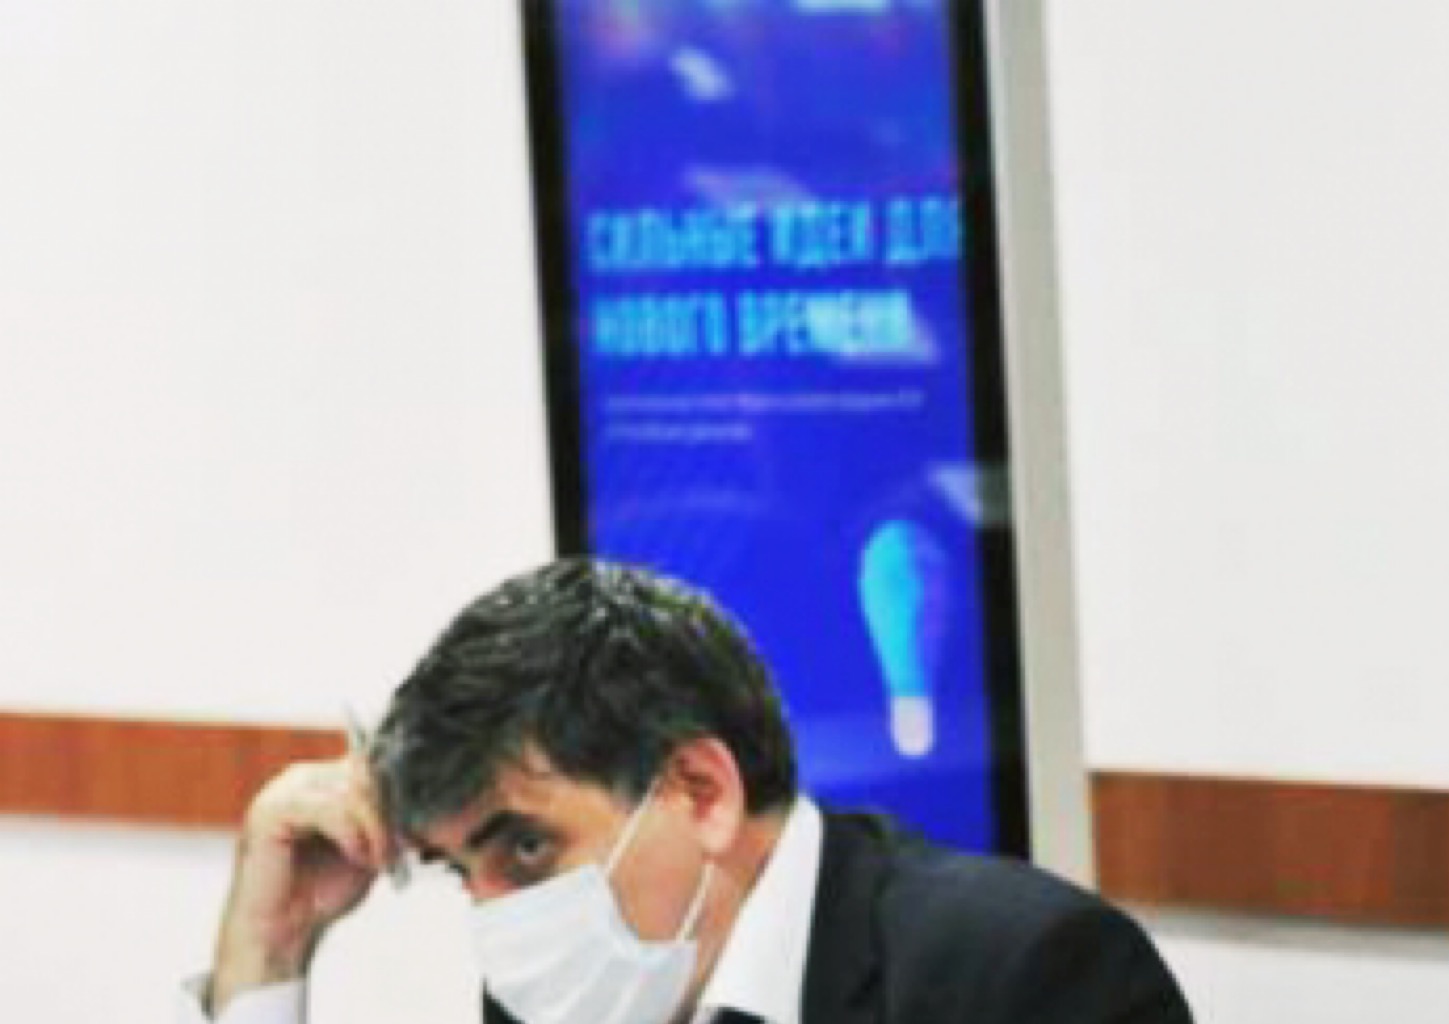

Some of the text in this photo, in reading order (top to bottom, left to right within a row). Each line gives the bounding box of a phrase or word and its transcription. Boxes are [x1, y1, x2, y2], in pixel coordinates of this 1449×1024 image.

[588, 204, 758, 271] СИЛЬНЫЕ
[771, 200, 873, 268] ИДЕИ
[593, 296, 728, 358] НОВОГО
